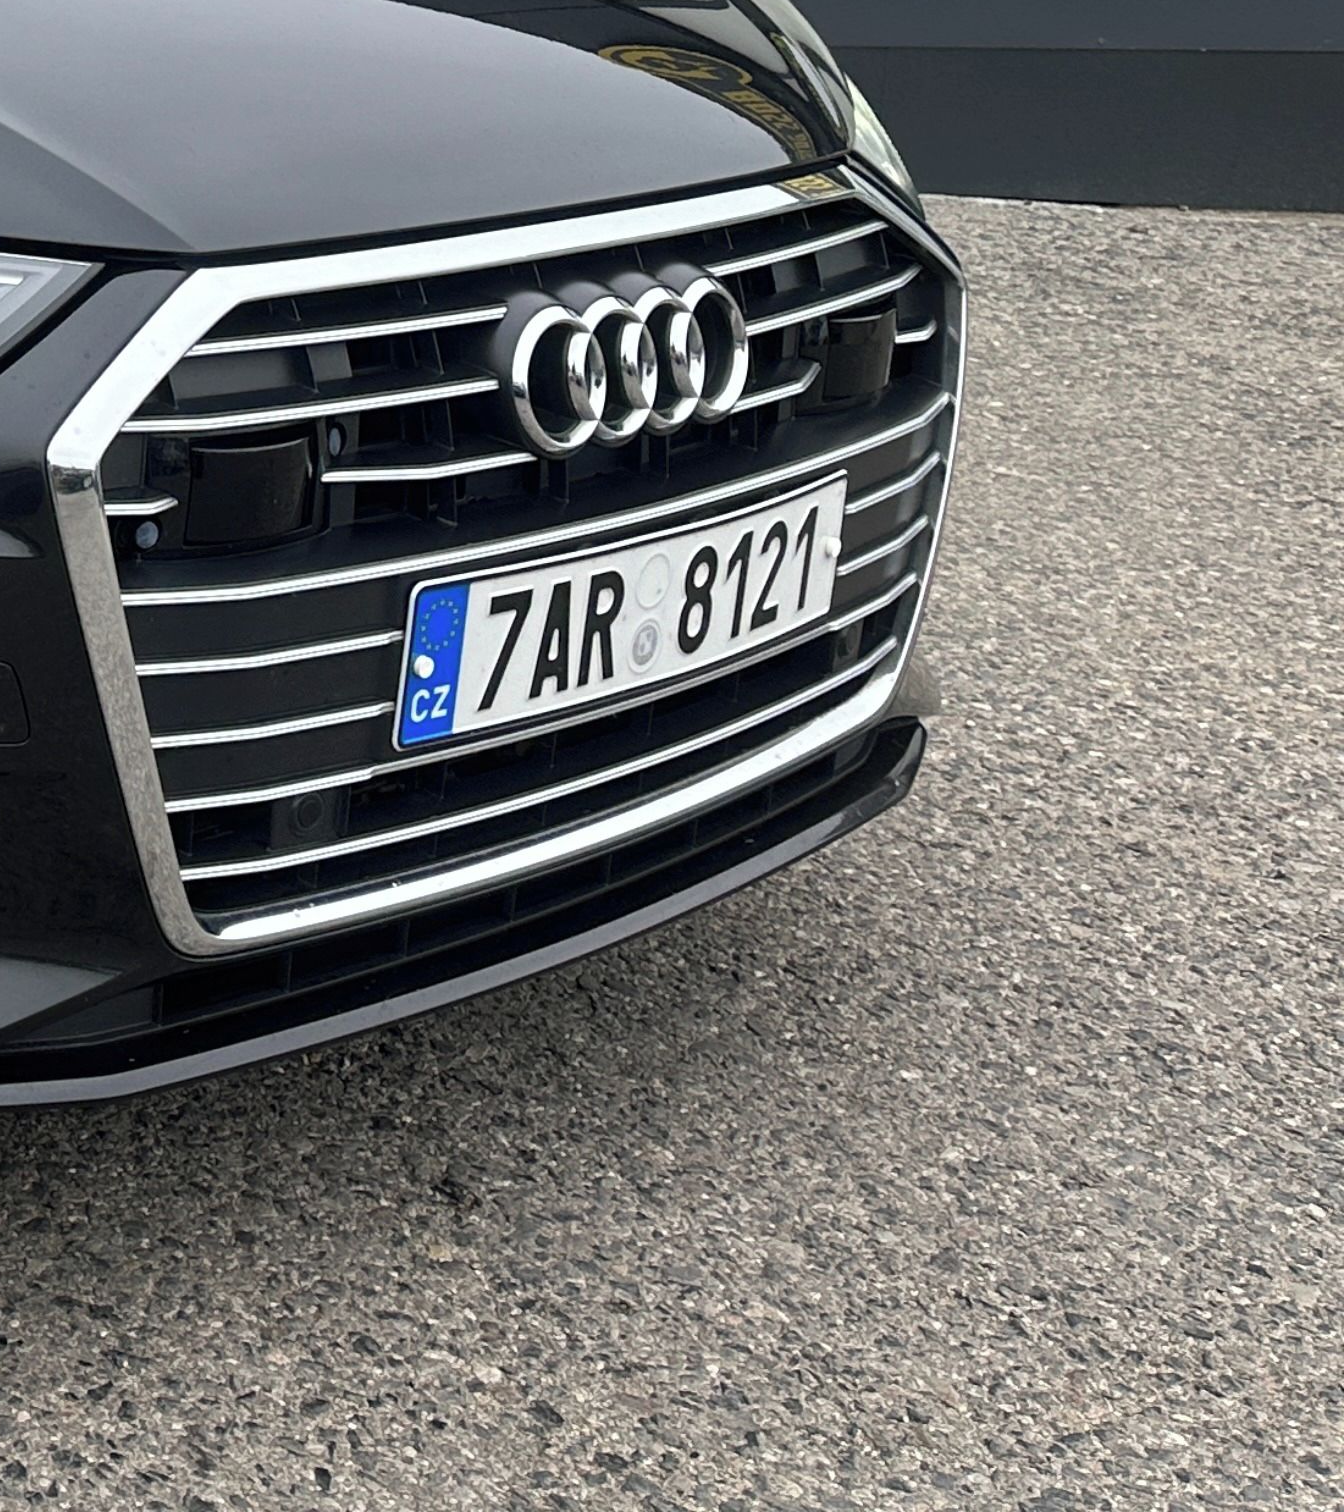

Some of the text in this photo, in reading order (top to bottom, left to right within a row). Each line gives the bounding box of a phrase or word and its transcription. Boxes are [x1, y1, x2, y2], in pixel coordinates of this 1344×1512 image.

[477, 505, 820, 712] 7AR 8121
[410, 685, 451, 722] CZ
